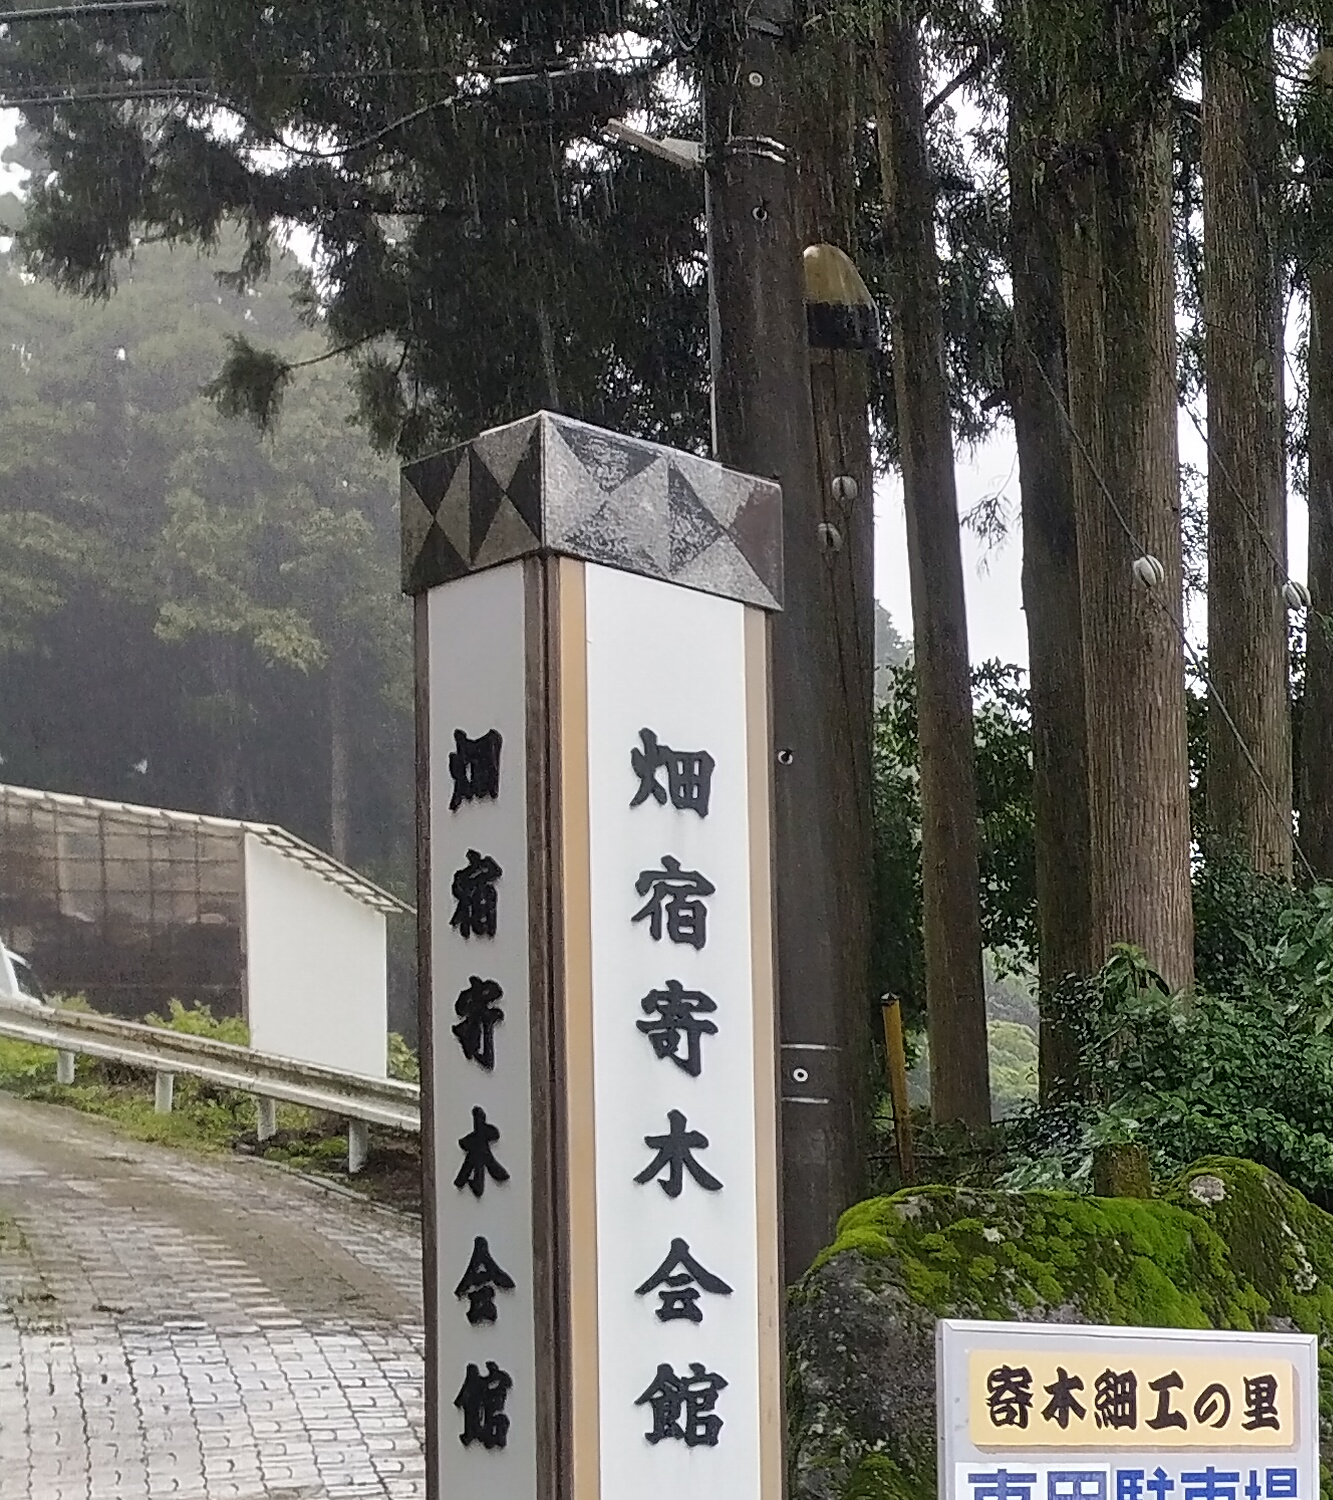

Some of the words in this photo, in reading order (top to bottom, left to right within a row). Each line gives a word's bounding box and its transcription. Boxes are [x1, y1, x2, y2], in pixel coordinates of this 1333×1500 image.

[449, 728, 517, 1452] 畑宿寄木会館
[630, 727, 733, 1448] 畑宿寄木会館
[986, 1364, 1281, 1431] 寄木細工の里
